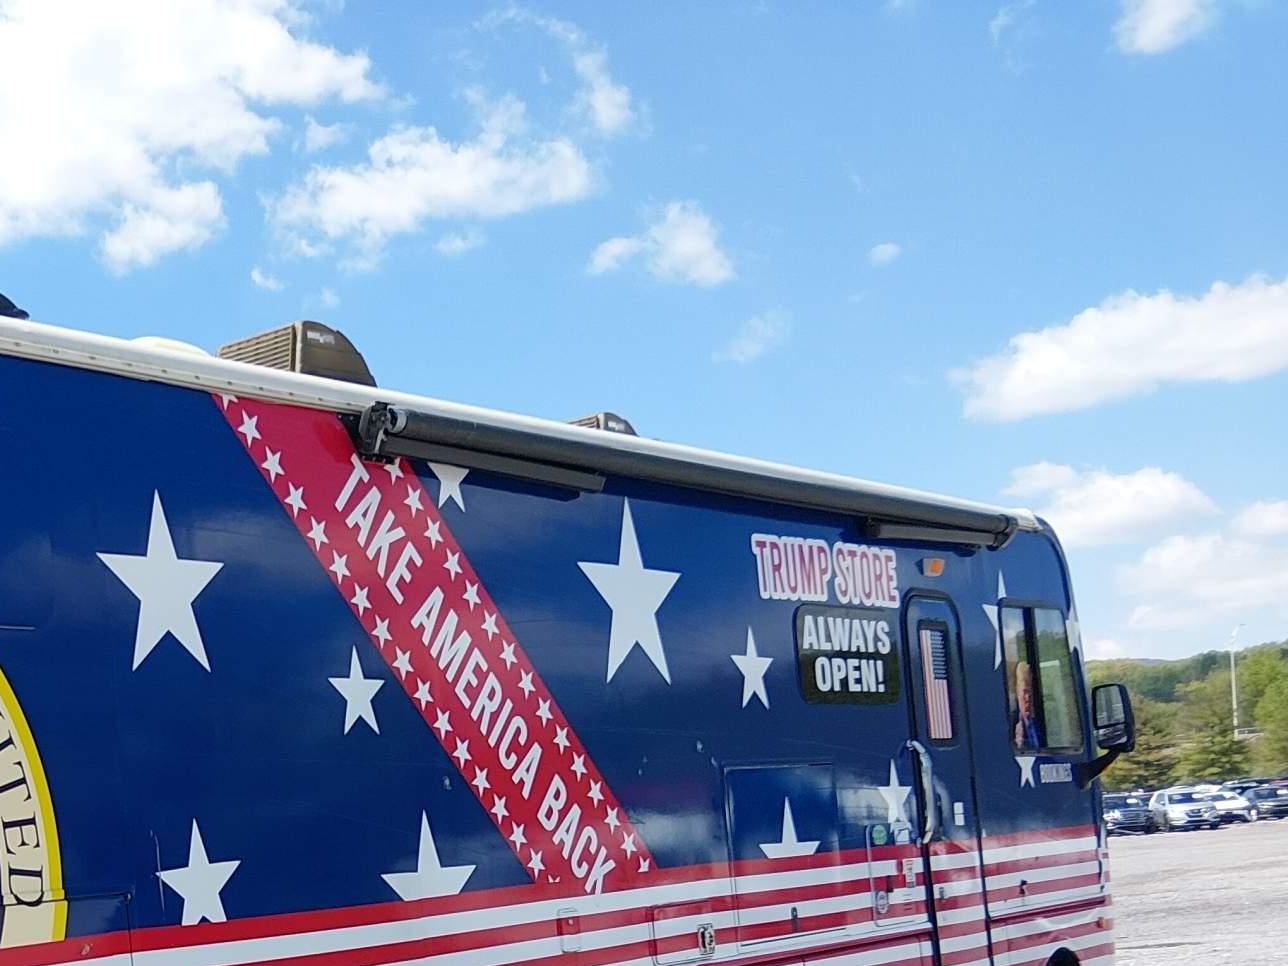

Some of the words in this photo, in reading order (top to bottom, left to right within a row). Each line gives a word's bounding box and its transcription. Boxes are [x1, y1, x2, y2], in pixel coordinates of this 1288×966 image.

[753, 536, 831, 600] TRUMP
[834, 544, 898, 607] STORE
[802, 615, 891, 655] ALWAYS
[334, 452, 423, 604] TAKE
[411, 586, 542, 800] AMERICA
[537, 773, 616, 895] BACK
[814, 656, 885, 693] OPEN!
